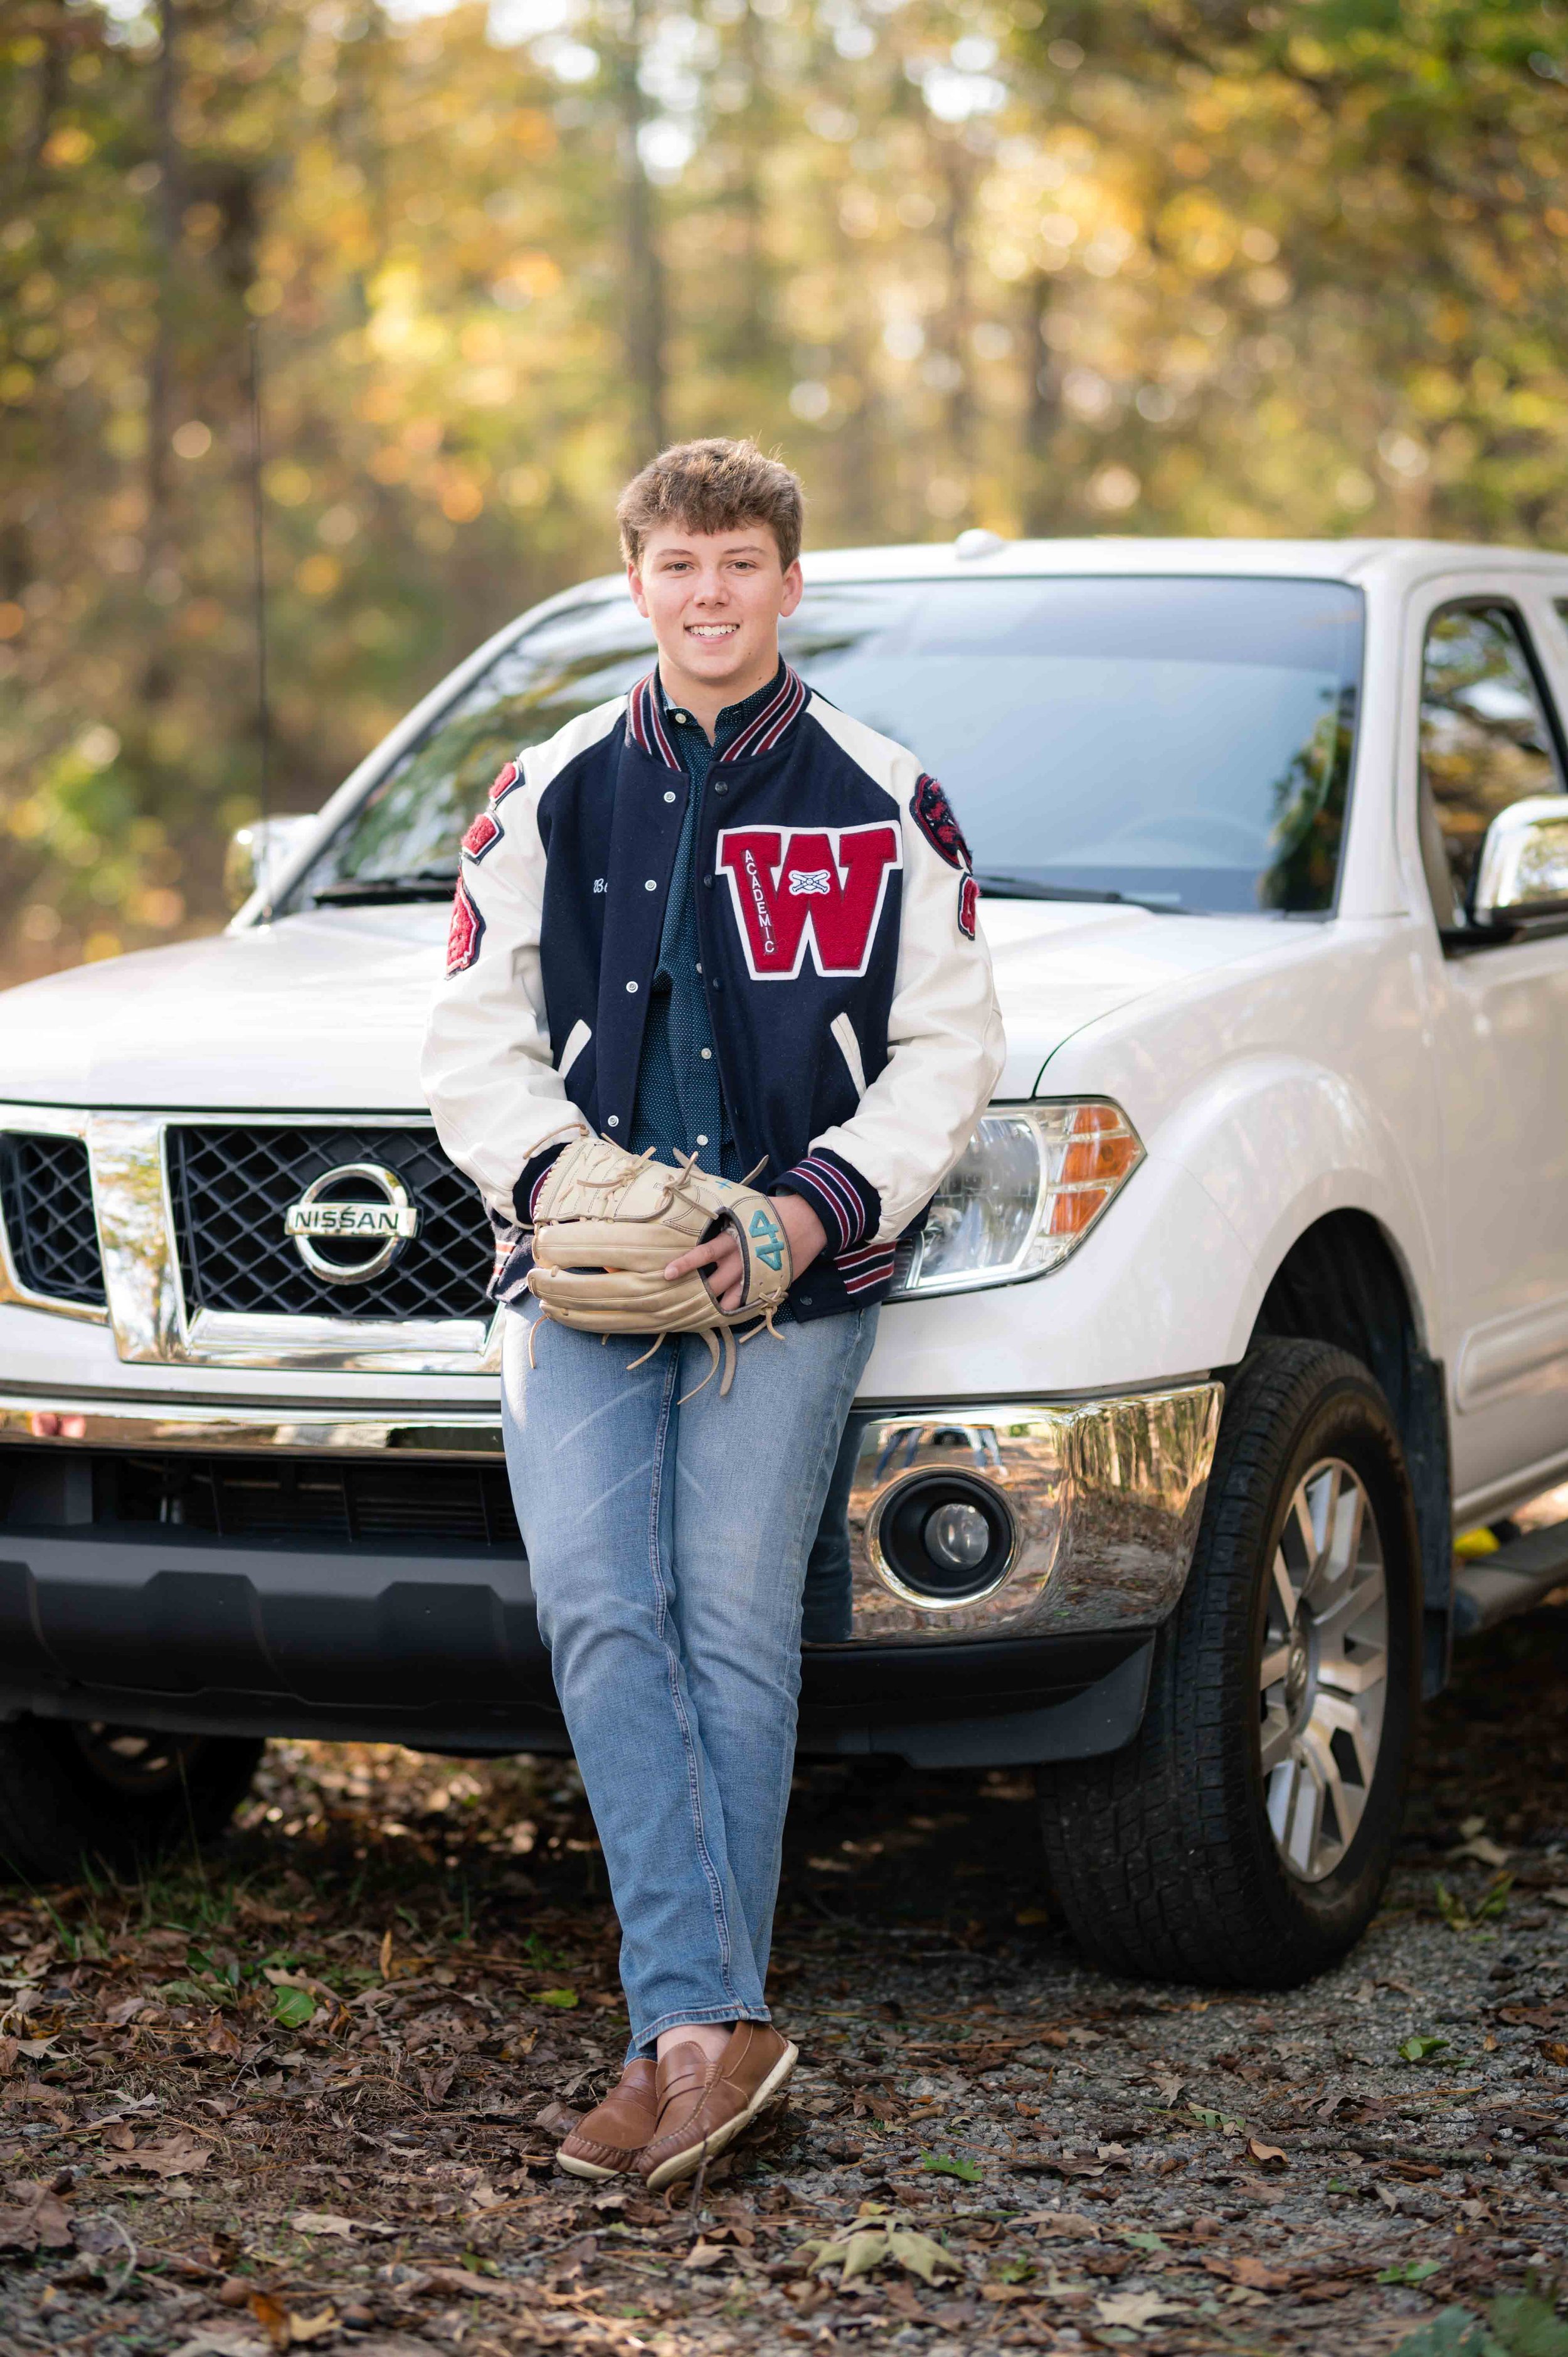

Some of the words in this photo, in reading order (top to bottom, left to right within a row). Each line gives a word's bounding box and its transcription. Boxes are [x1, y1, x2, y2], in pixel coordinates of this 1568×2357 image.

[716, 820, 903, 980] W
[744, 849, 775, 953] ACADEMIC
[294, 1210, 399, 1230] NISSAN
[748, 1210, 785, 1271] 44
